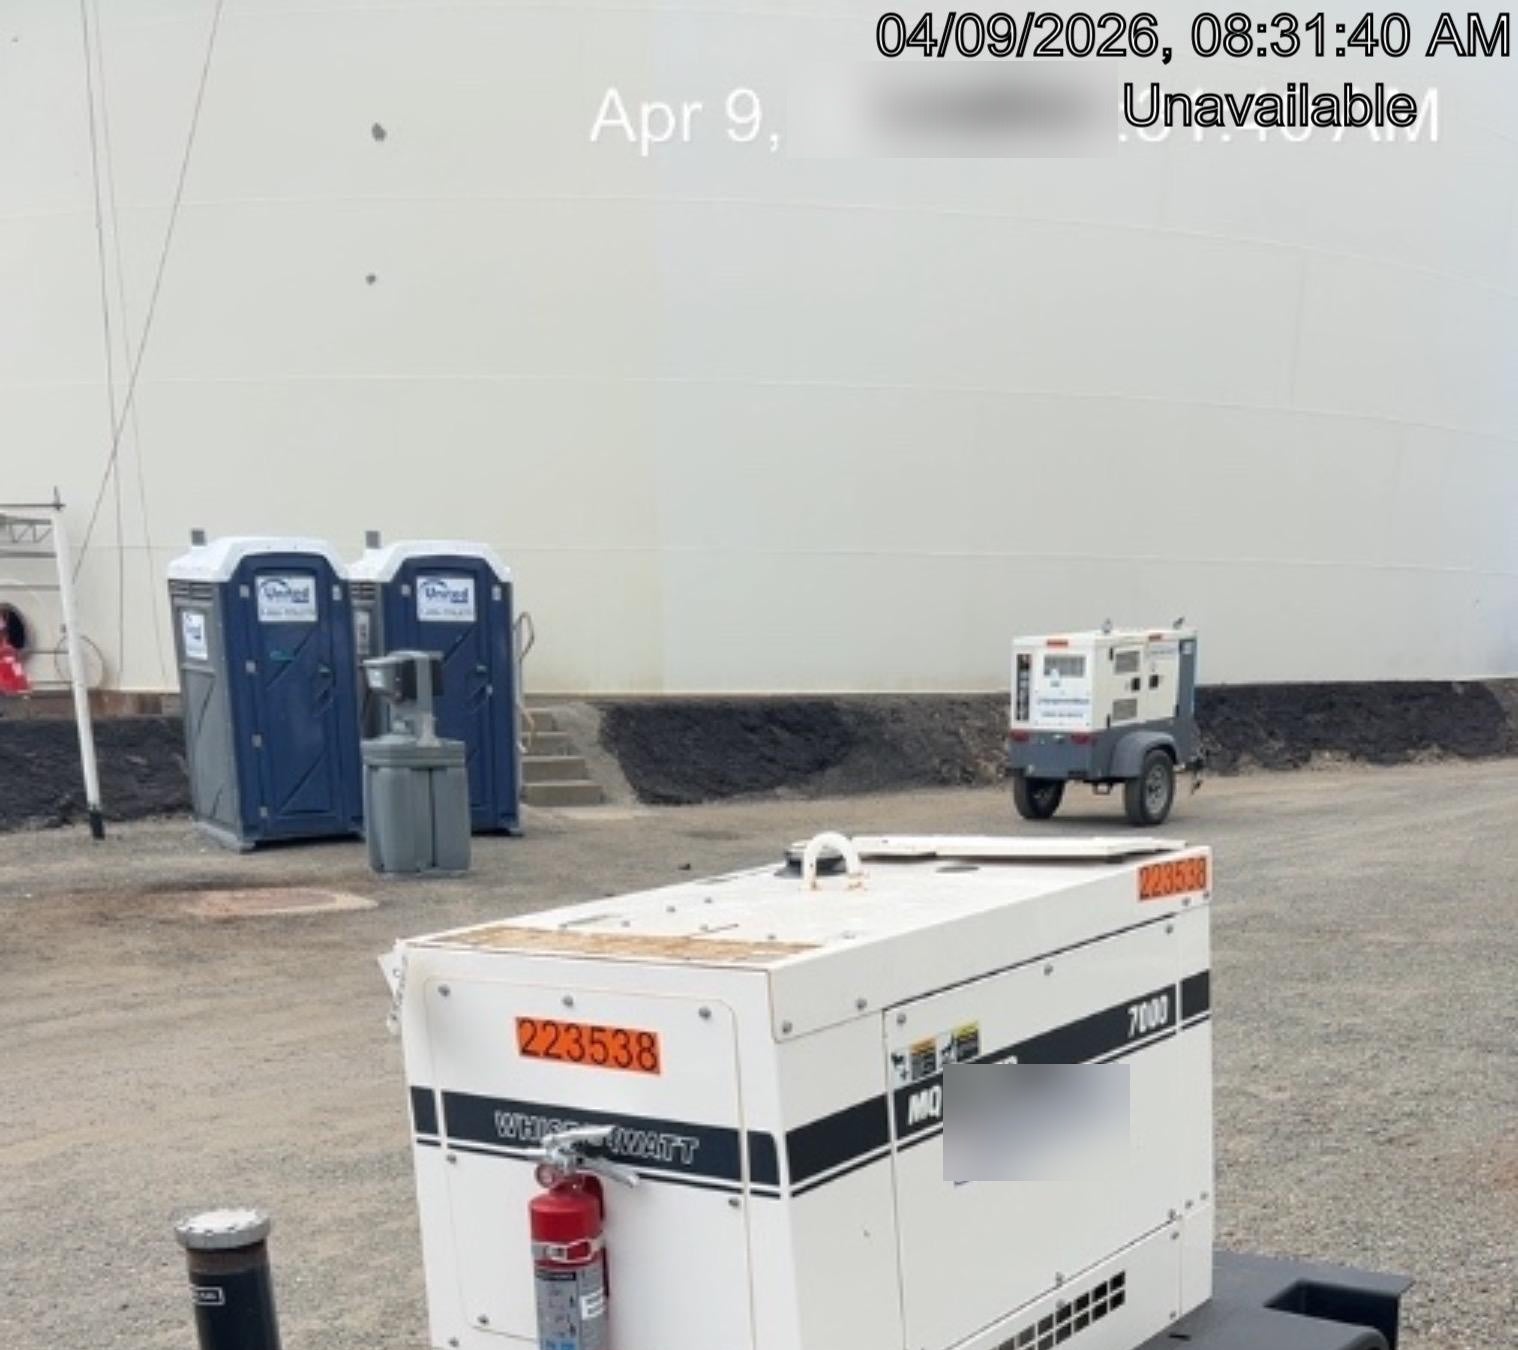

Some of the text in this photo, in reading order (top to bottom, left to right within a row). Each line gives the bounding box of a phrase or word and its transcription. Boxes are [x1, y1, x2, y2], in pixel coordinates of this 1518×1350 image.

[1127, 994, 1168, 1039] 7000
[518, 1019, 658, 1071] 223538
[908, 1085, 942, 1125] MQ
